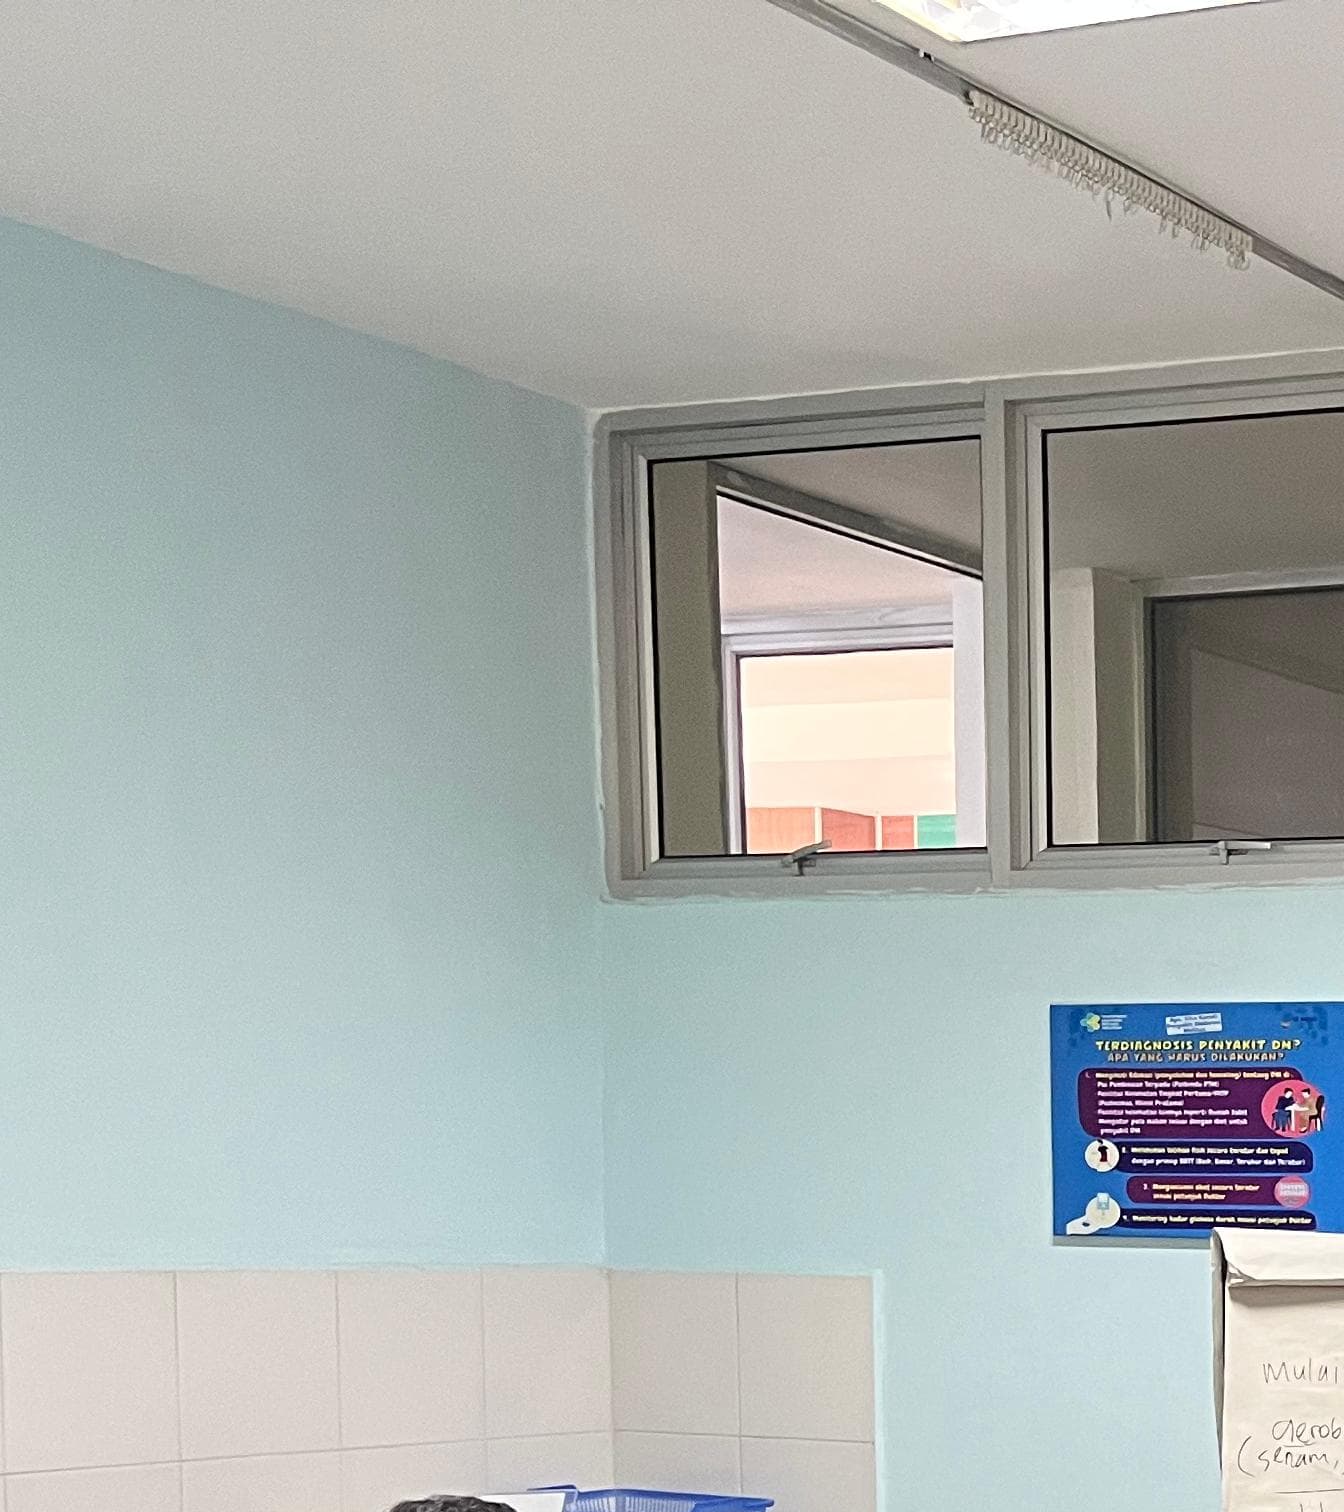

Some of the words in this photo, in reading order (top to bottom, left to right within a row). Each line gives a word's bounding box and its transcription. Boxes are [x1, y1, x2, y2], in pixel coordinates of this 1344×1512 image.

[1095, 1039, 1193, 1051] TERDIAGNOSIS
[1199, 1039, 1267, 1050] PENYAKIT
[1272, 1039, 1303, 1050] DM?
[1107, 1053, 1129, 1062] APA
[1134, 1052, 1164, 1062] YANG
[1168, 1052, 1206, 1062] HARUS
[1211, 1051, 1284, 1061] DILAKUKAN?
